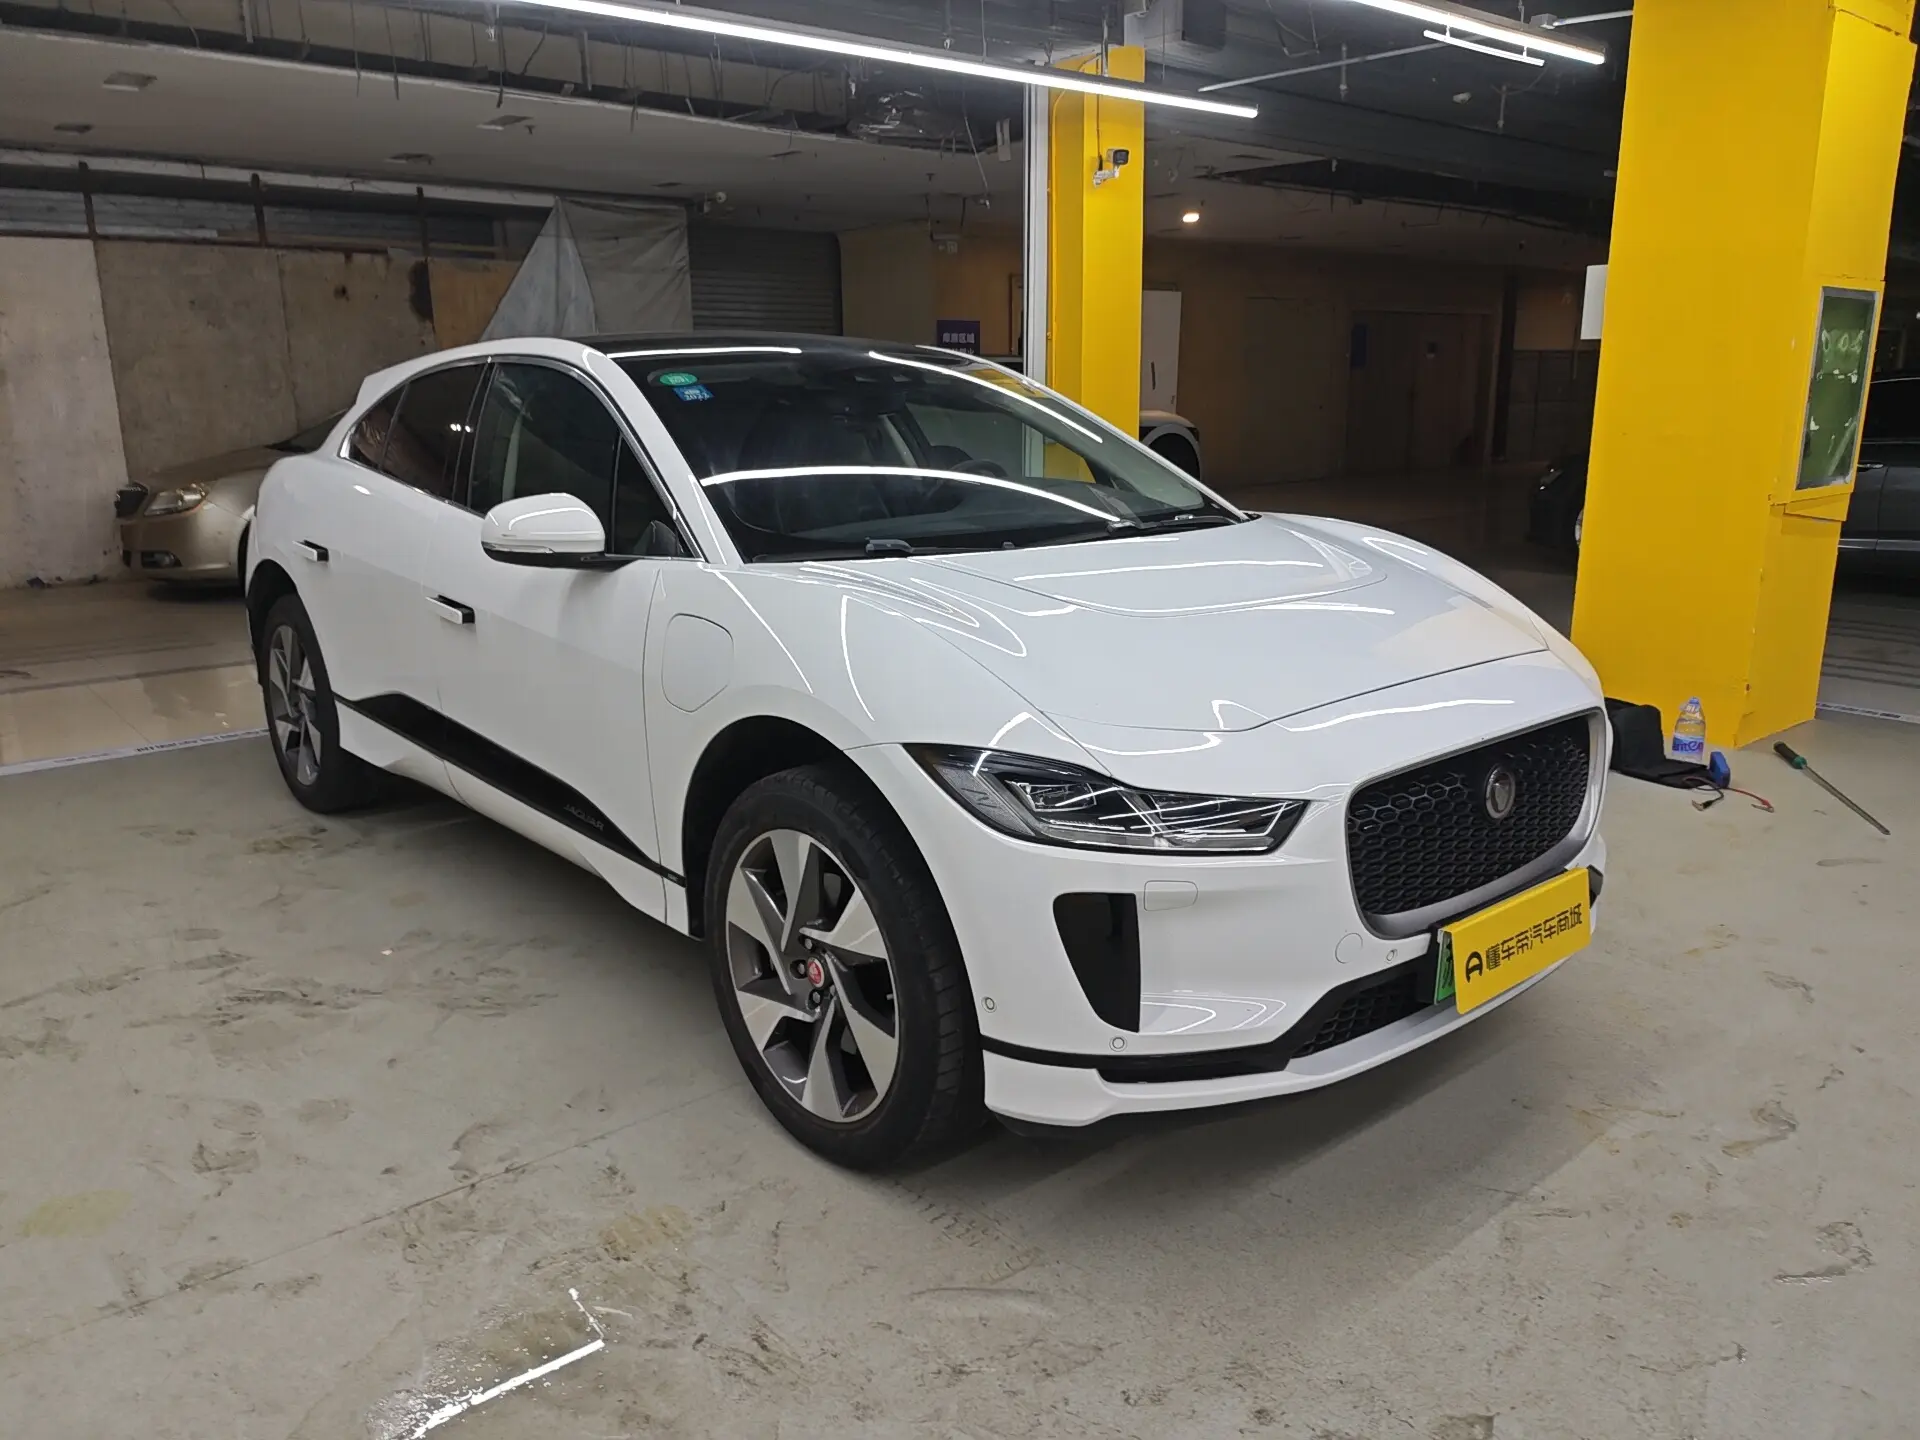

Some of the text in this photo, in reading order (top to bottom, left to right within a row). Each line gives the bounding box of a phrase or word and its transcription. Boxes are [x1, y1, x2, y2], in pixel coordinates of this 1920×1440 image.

[563, 804, 605, 831] JAGUAR
[1486, 903, 1583, 971] 懂车帝汽车商城
